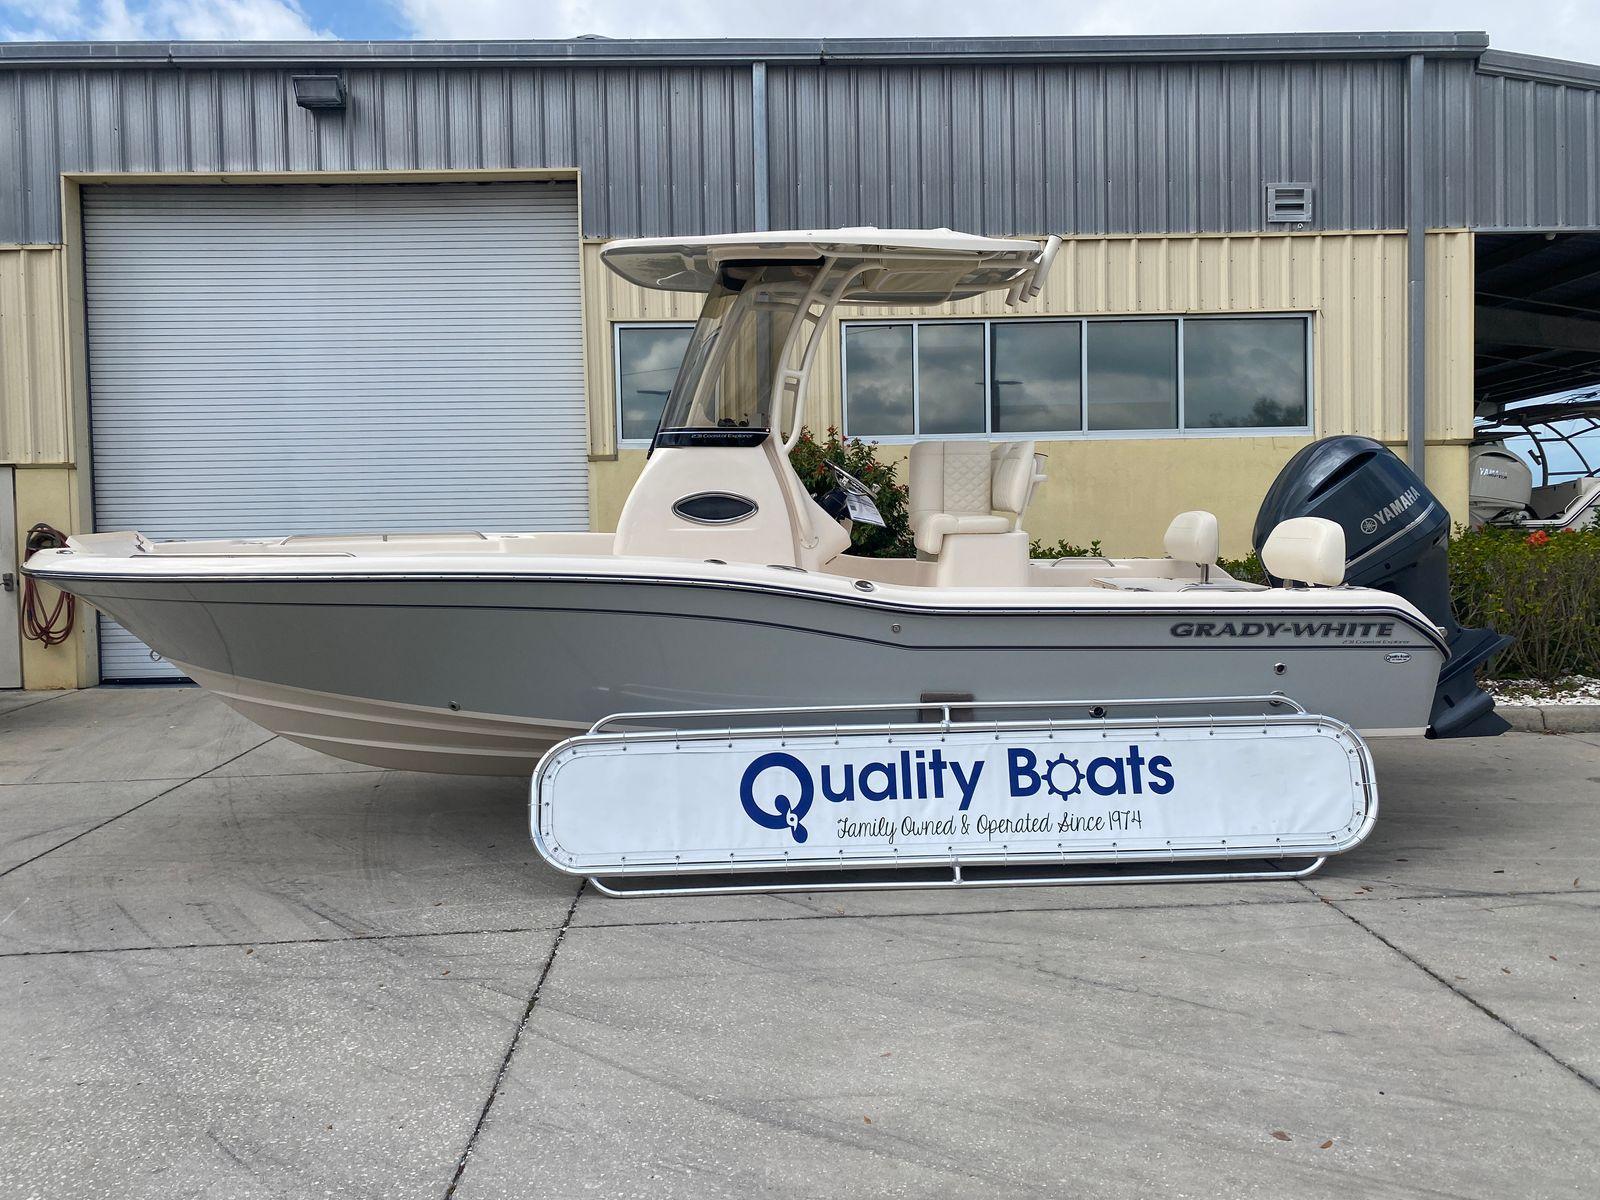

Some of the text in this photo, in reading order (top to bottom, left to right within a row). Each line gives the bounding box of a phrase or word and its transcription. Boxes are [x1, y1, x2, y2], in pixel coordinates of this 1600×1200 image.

[1374, 486, 1421, 525] YAMAHA
[1170, 622, 1395, 638] GRADY-WHITE
[740, 745, 1175, 843] Quality Boats
[837, 809, 1143, 844] Family Owned & Operated Since 1974
